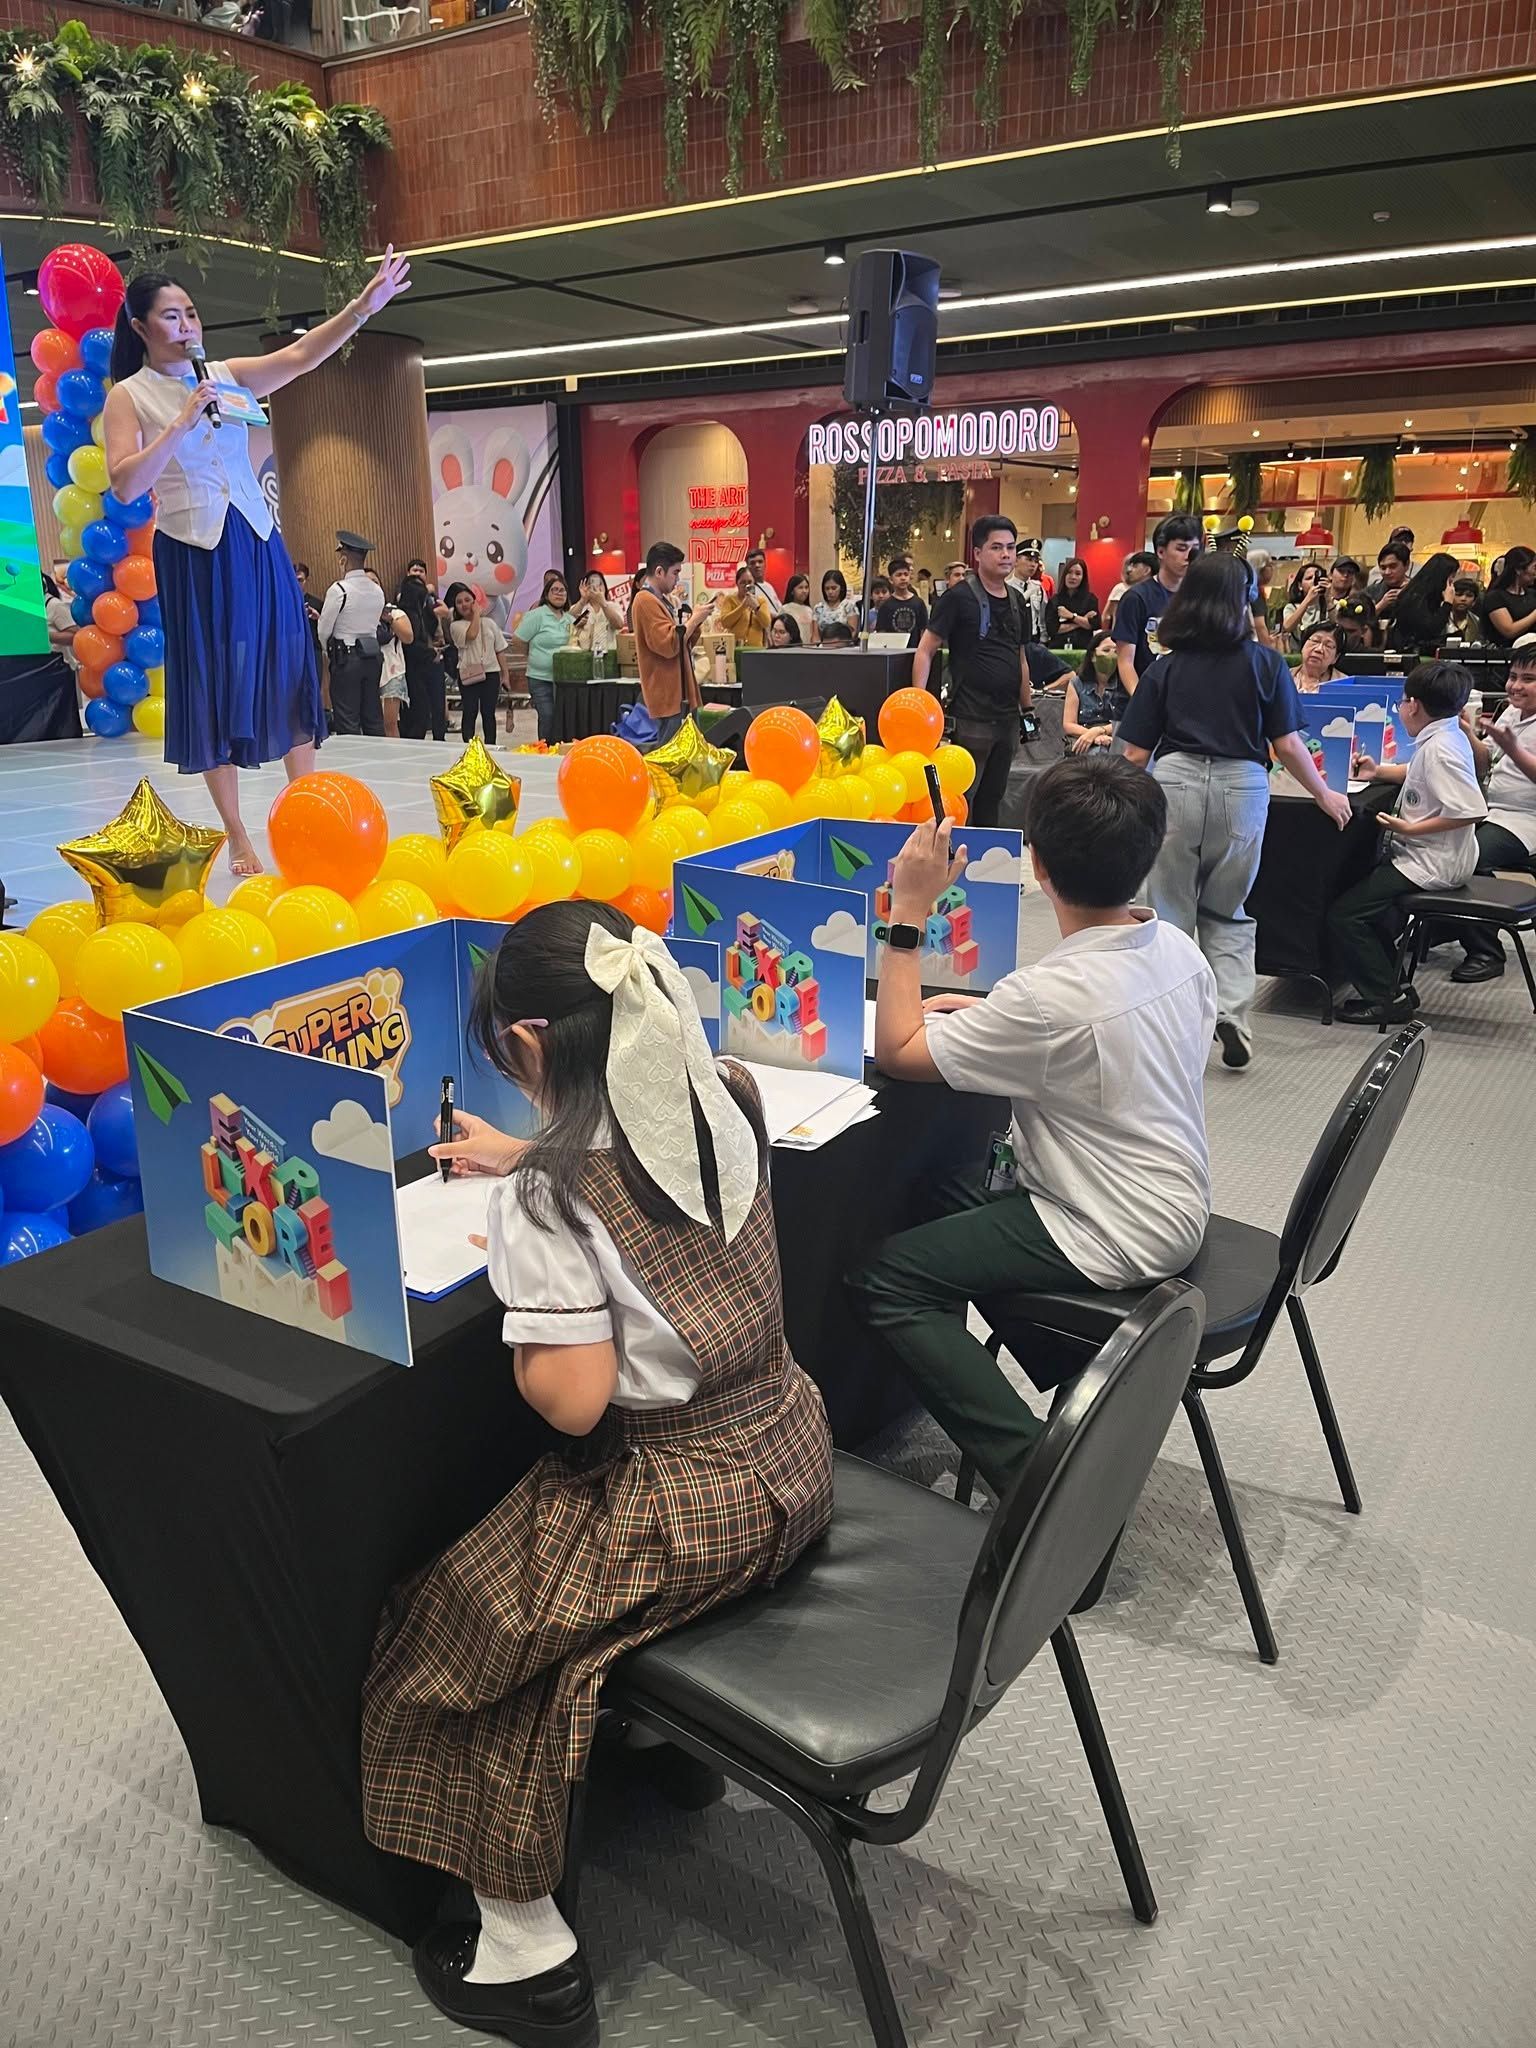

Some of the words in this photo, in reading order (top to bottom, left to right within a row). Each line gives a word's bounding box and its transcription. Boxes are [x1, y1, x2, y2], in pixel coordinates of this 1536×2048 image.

[809, 405, 1059, 465] ROSSOPOMODORO
[857, 466, 907, 485] PZZA
[914, 466, 929, 483] &
[937, 462, 993, 482] PASTA
[688, 487, 716, 509] THE
[719, 485, 747, 507] ART
